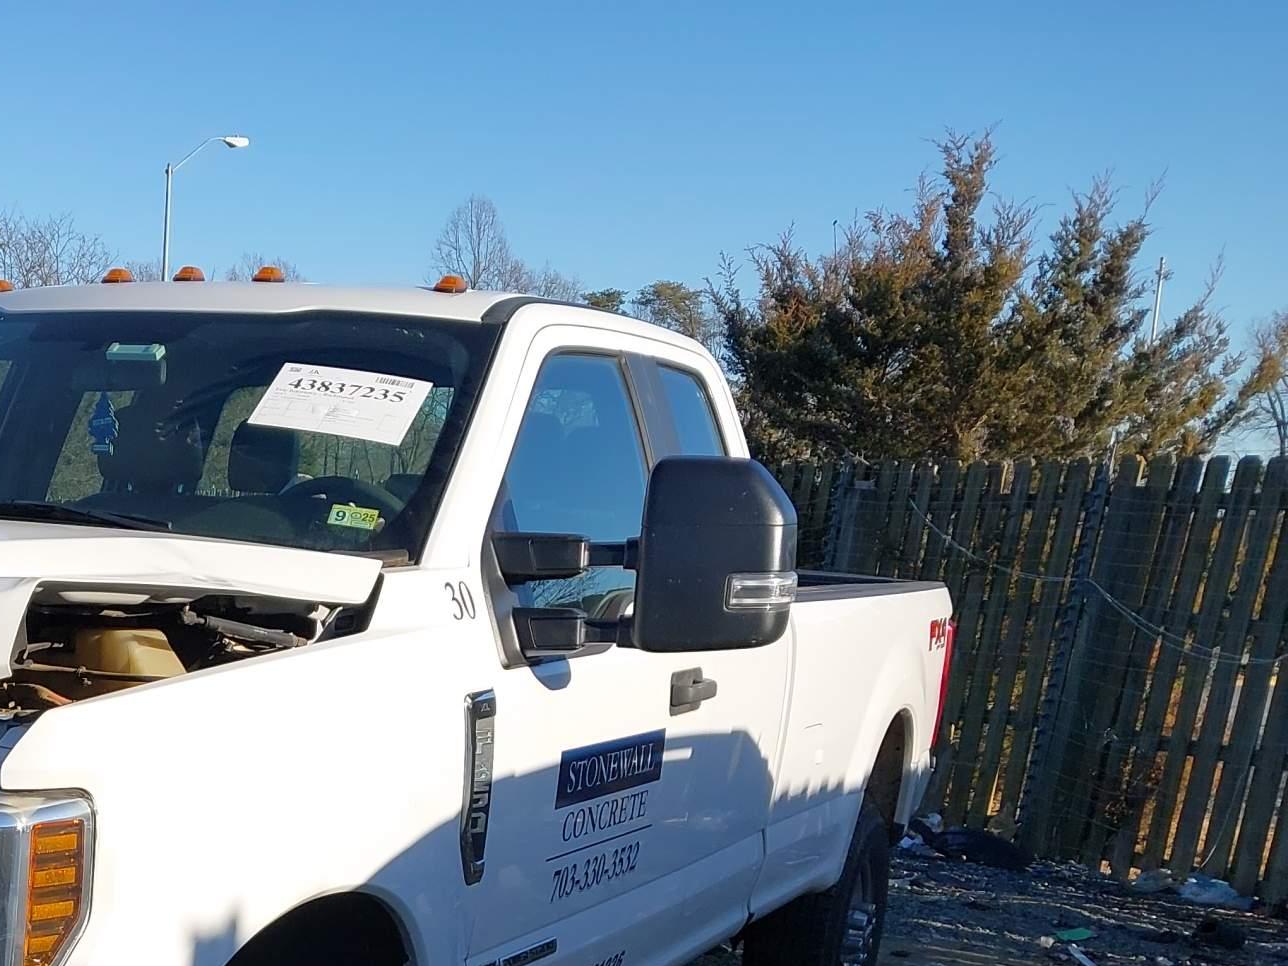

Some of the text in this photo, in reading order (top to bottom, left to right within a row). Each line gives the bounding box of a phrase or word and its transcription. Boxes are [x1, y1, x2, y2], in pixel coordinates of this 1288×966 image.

[288, 377, 408, 403] 43837235
[334, 510, 377, 523] 9 25
[444, 581, 476, 621] 30
[567, 743, 655, 793] STONEWALL
[562, 790, 649, 842] CONCRETE
[550, 841, 640, 904] 703-330-3532
